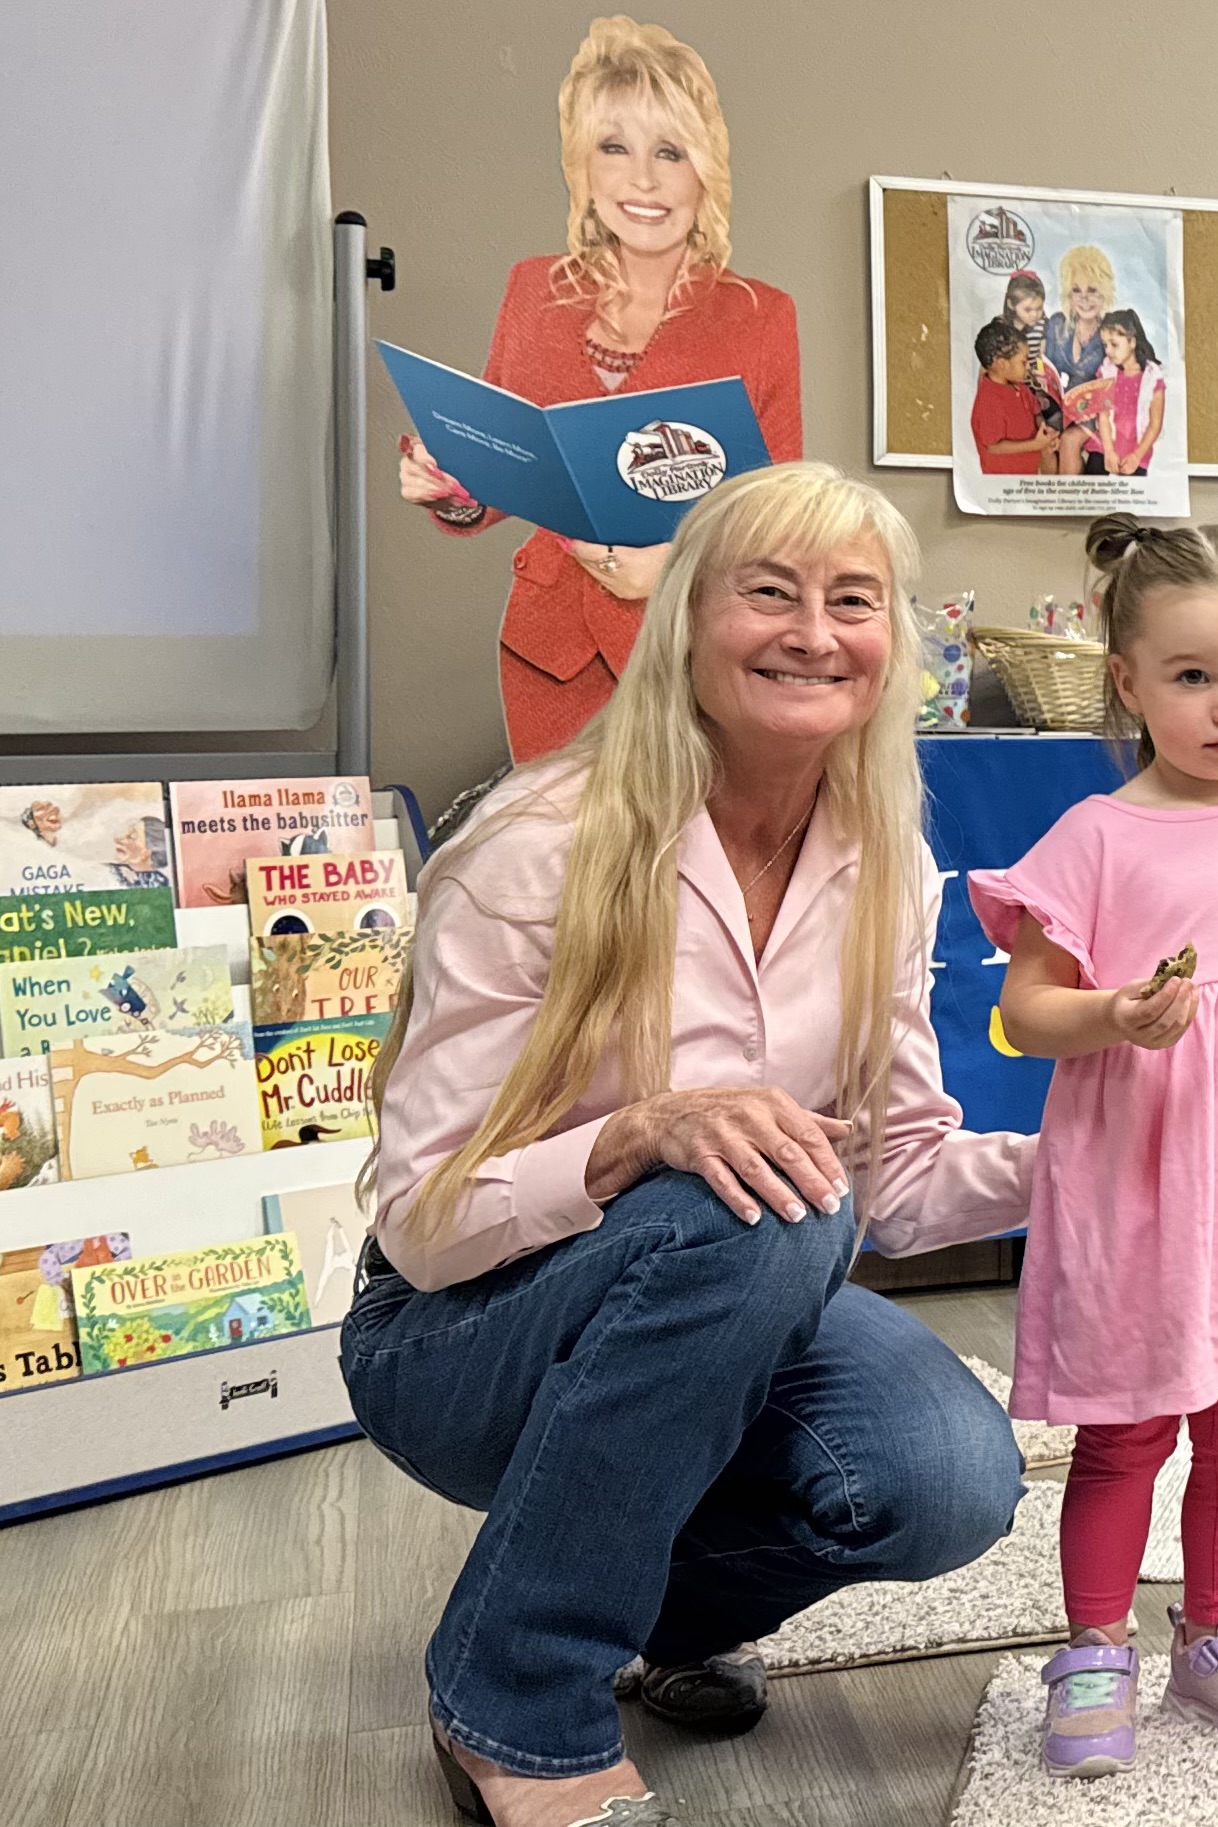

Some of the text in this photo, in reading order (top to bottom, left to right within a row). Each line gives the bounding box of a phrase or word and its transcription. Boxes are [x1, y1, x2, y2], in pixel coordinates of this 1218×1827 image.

[629, 461, 727, 492] IMAGINATION
[652, 477, 713, 500] LIBRARY
[222, 788, 325, 808] llama llama
[181, 809, 368, 834] meets the babysitter
[22, 864, 71, 881] GAGA
[259, 857, 395, 892] THE BABY
[264, 887, 397, 906] WHO STAYED AWAKE
[64, 899, 135, 928] New,
[12, 976, 70, 998] When
[339, 965, 378, 991] OUR
[16, 1003, 112, 1028] You Love
[255, 1037, 380, 1083] Don't Lose
[17, 1068, 50, 1089] His
[92, 1085, 225, 1116] Exactly as Planned
[261, 1083, 296, 1119] Mr.
[110, 1273, 168, 1305] OVER
[188, 1256, 272, 1290] GARDEN
[15, 1341, 82, 1377] Tabl
